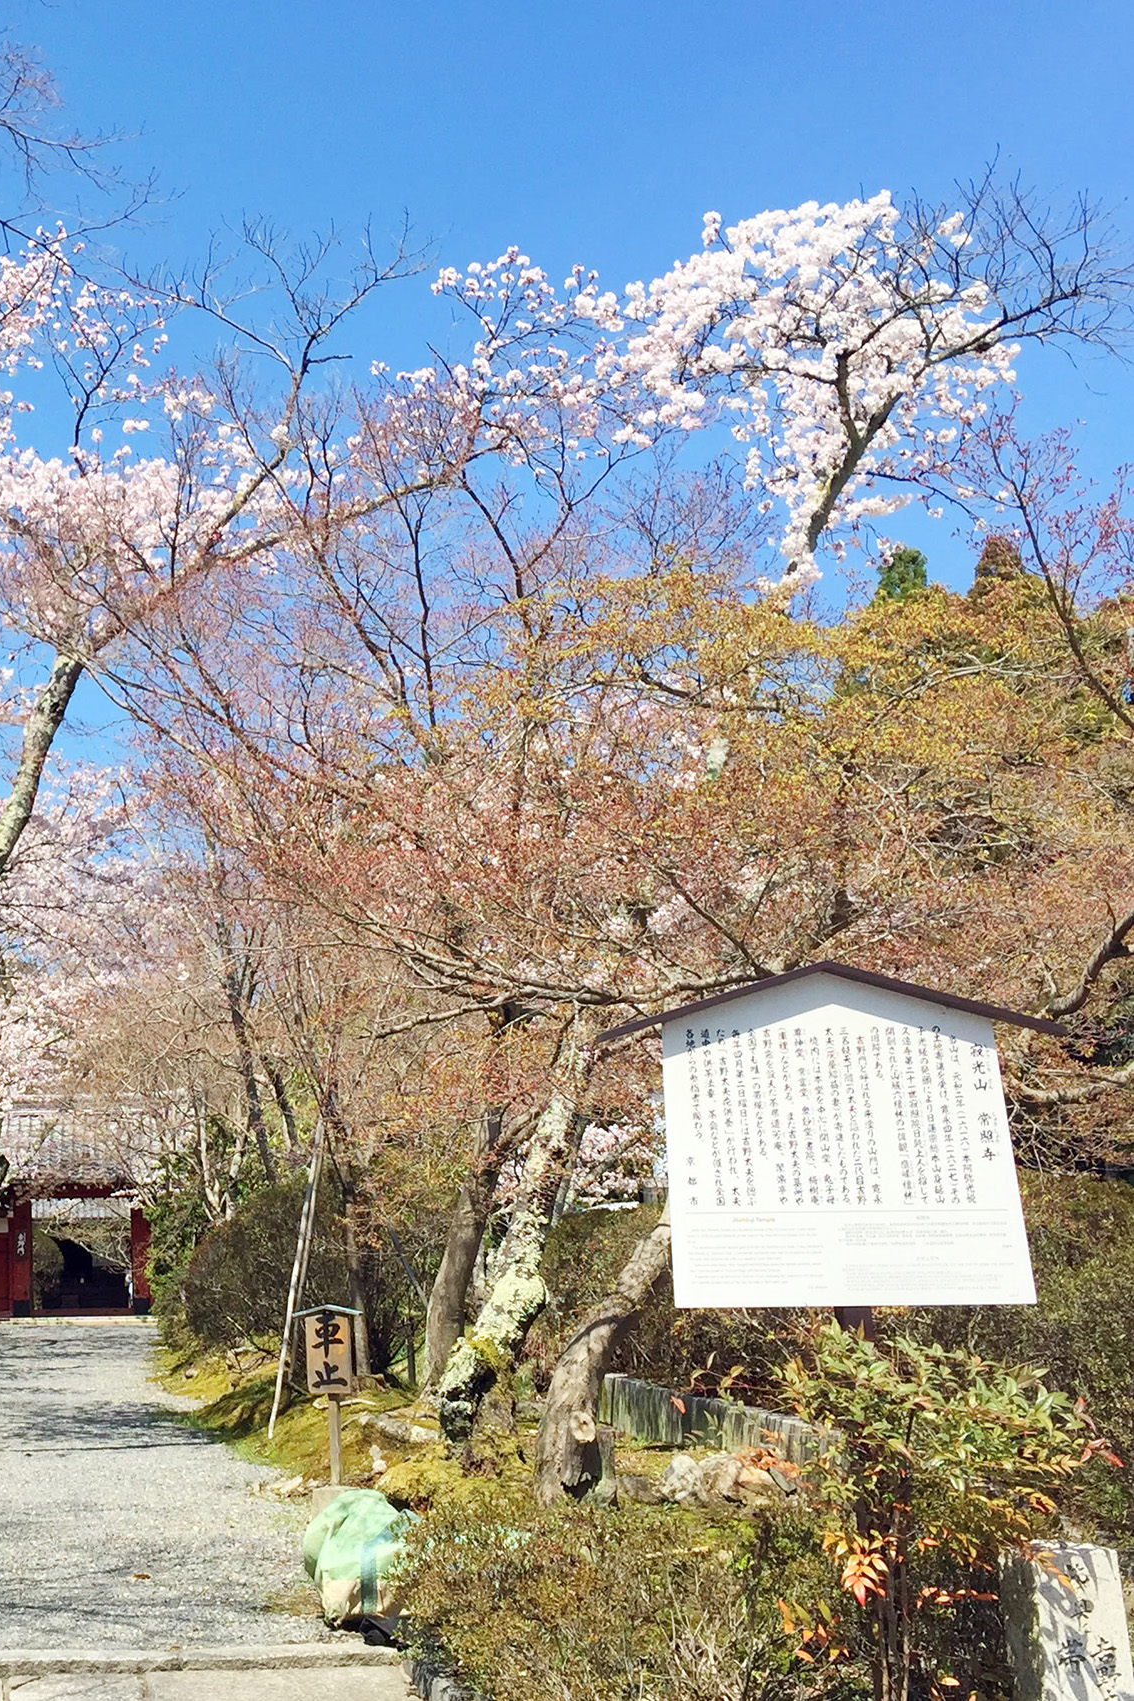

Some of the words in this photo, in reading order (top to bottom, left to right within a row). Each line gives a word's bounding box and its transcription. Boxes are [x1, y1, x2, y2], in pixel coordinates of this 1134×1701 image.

[970, 1043, 988, 1092] 寂光山
[977, 1111, 996, 1162] 常照寺
[311, 1311, 348, 1389] 車止
